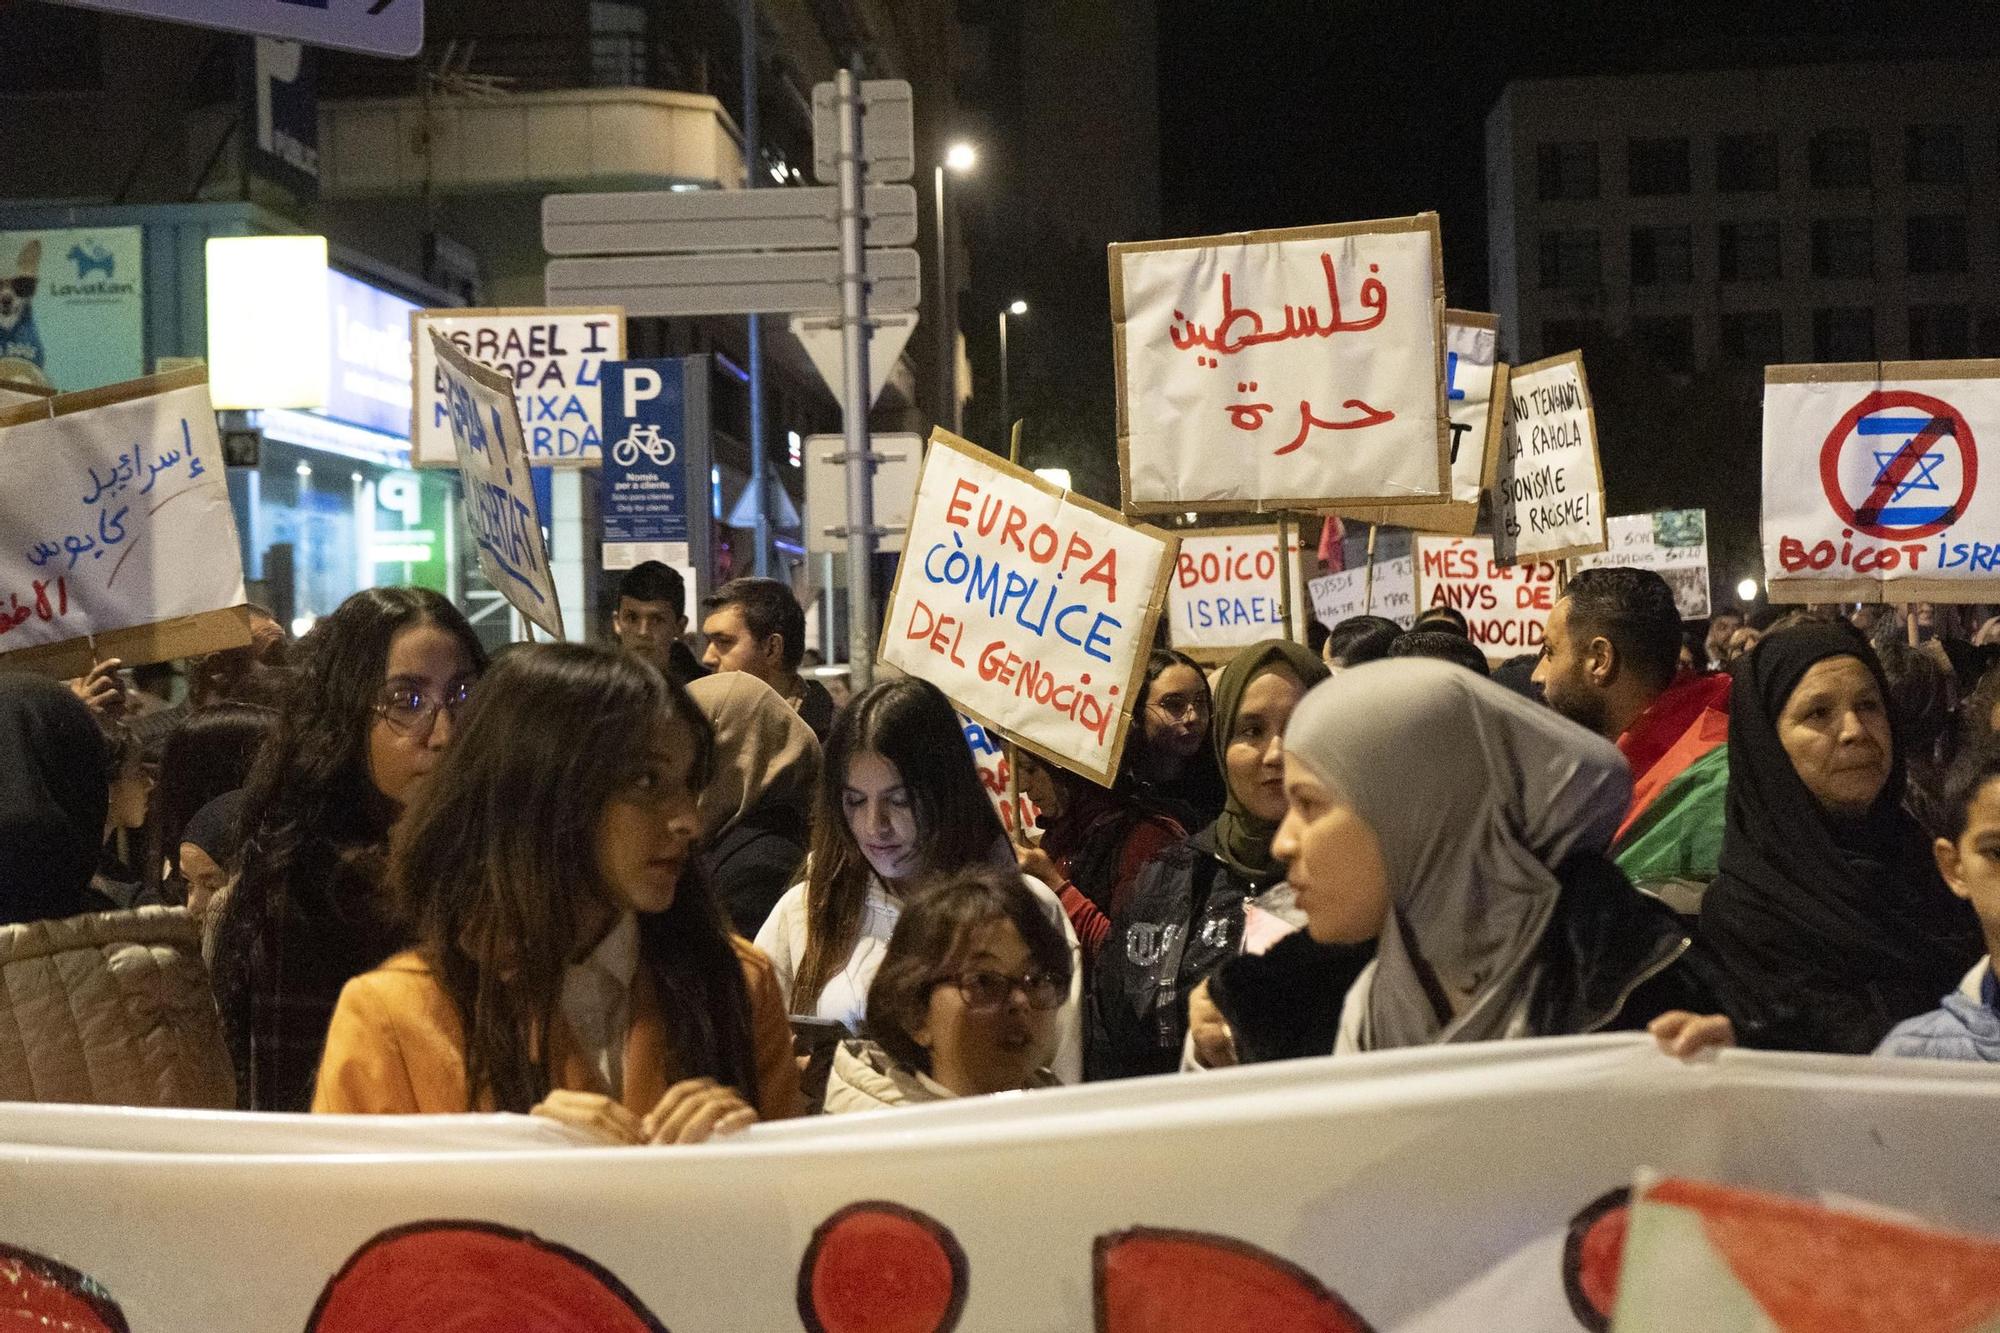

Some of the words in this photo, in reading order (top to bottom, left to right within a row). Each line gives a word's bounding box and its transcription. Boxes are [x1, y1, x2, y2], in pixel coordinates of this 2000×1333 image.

[1169, 251, 1388, 369] فلسطين
[443, 323, 568, 360] SRAEL
[623, 367, 662, 418] P
[1224, 381, 1396, 456] حرة
[83, 418, 206, 505] إسرائيل
[1506, 434, 1524, 464] LA
[1531, 419, 1582, 457] RAHOLA
[26, 506, 129, 571] كابوس
[946, 477, 1118, 604] EUROPA
[1423, 537, 1479, 579] MÉS
[1187, 597, 1284, 629] ISRAEL
[1430, 583, 1498, 610] ANYS
[1516, 585, 1553, 610] DE
[907, 600, 966, 669] DEL
